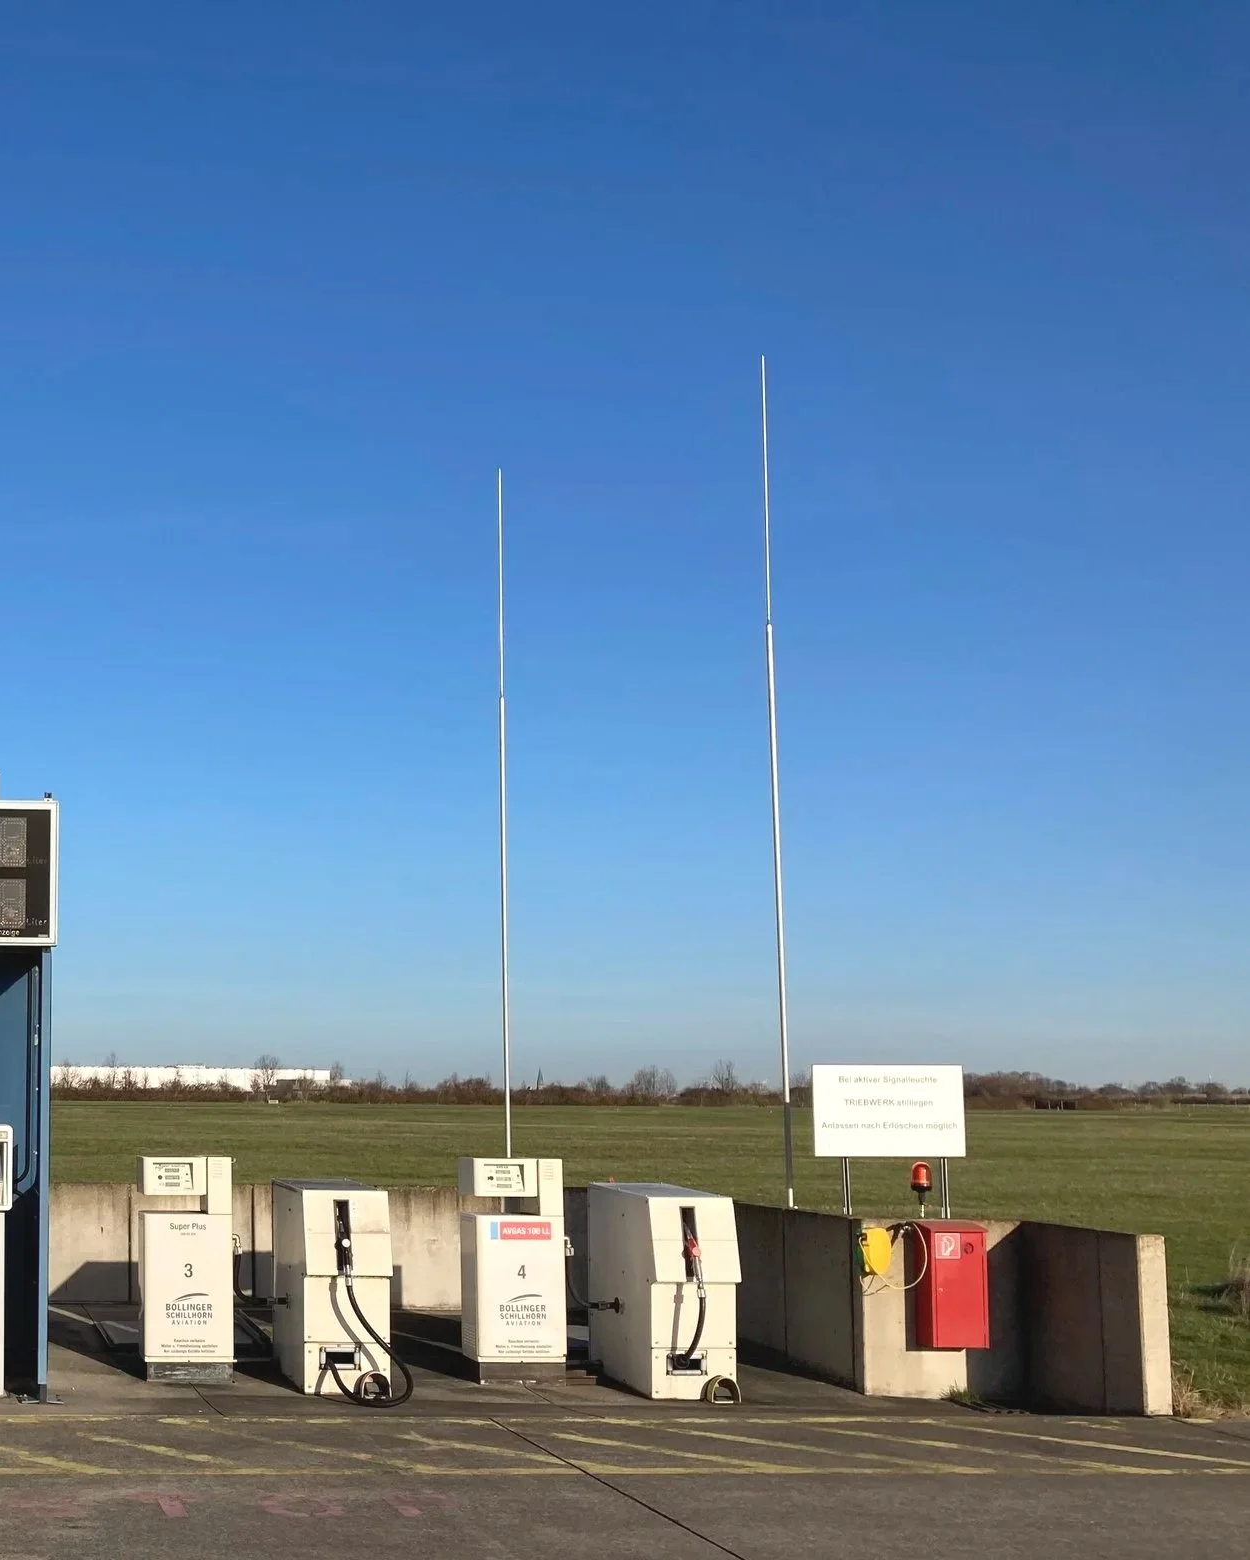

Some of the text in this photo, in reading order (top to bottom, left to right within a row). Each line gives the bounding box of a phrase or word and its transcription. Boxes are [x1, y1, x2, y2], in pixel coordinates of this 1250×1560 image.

[838, 1075, 852, 1084] Bei
[854, 1076, 881, 1084] aktiver
[926, 1122, 958, 1131] möglich
[169, 1223, 190, 1231] Super
[502, 1227, 527, 1235] AVGAS
[184, 1263, 193, 1278] 3
[517, 1265, 526, 1279] 4
[165, 1303, 213, 1311] BOLLINGER
[499, 1304, 546, 1312] BOLLINGER
